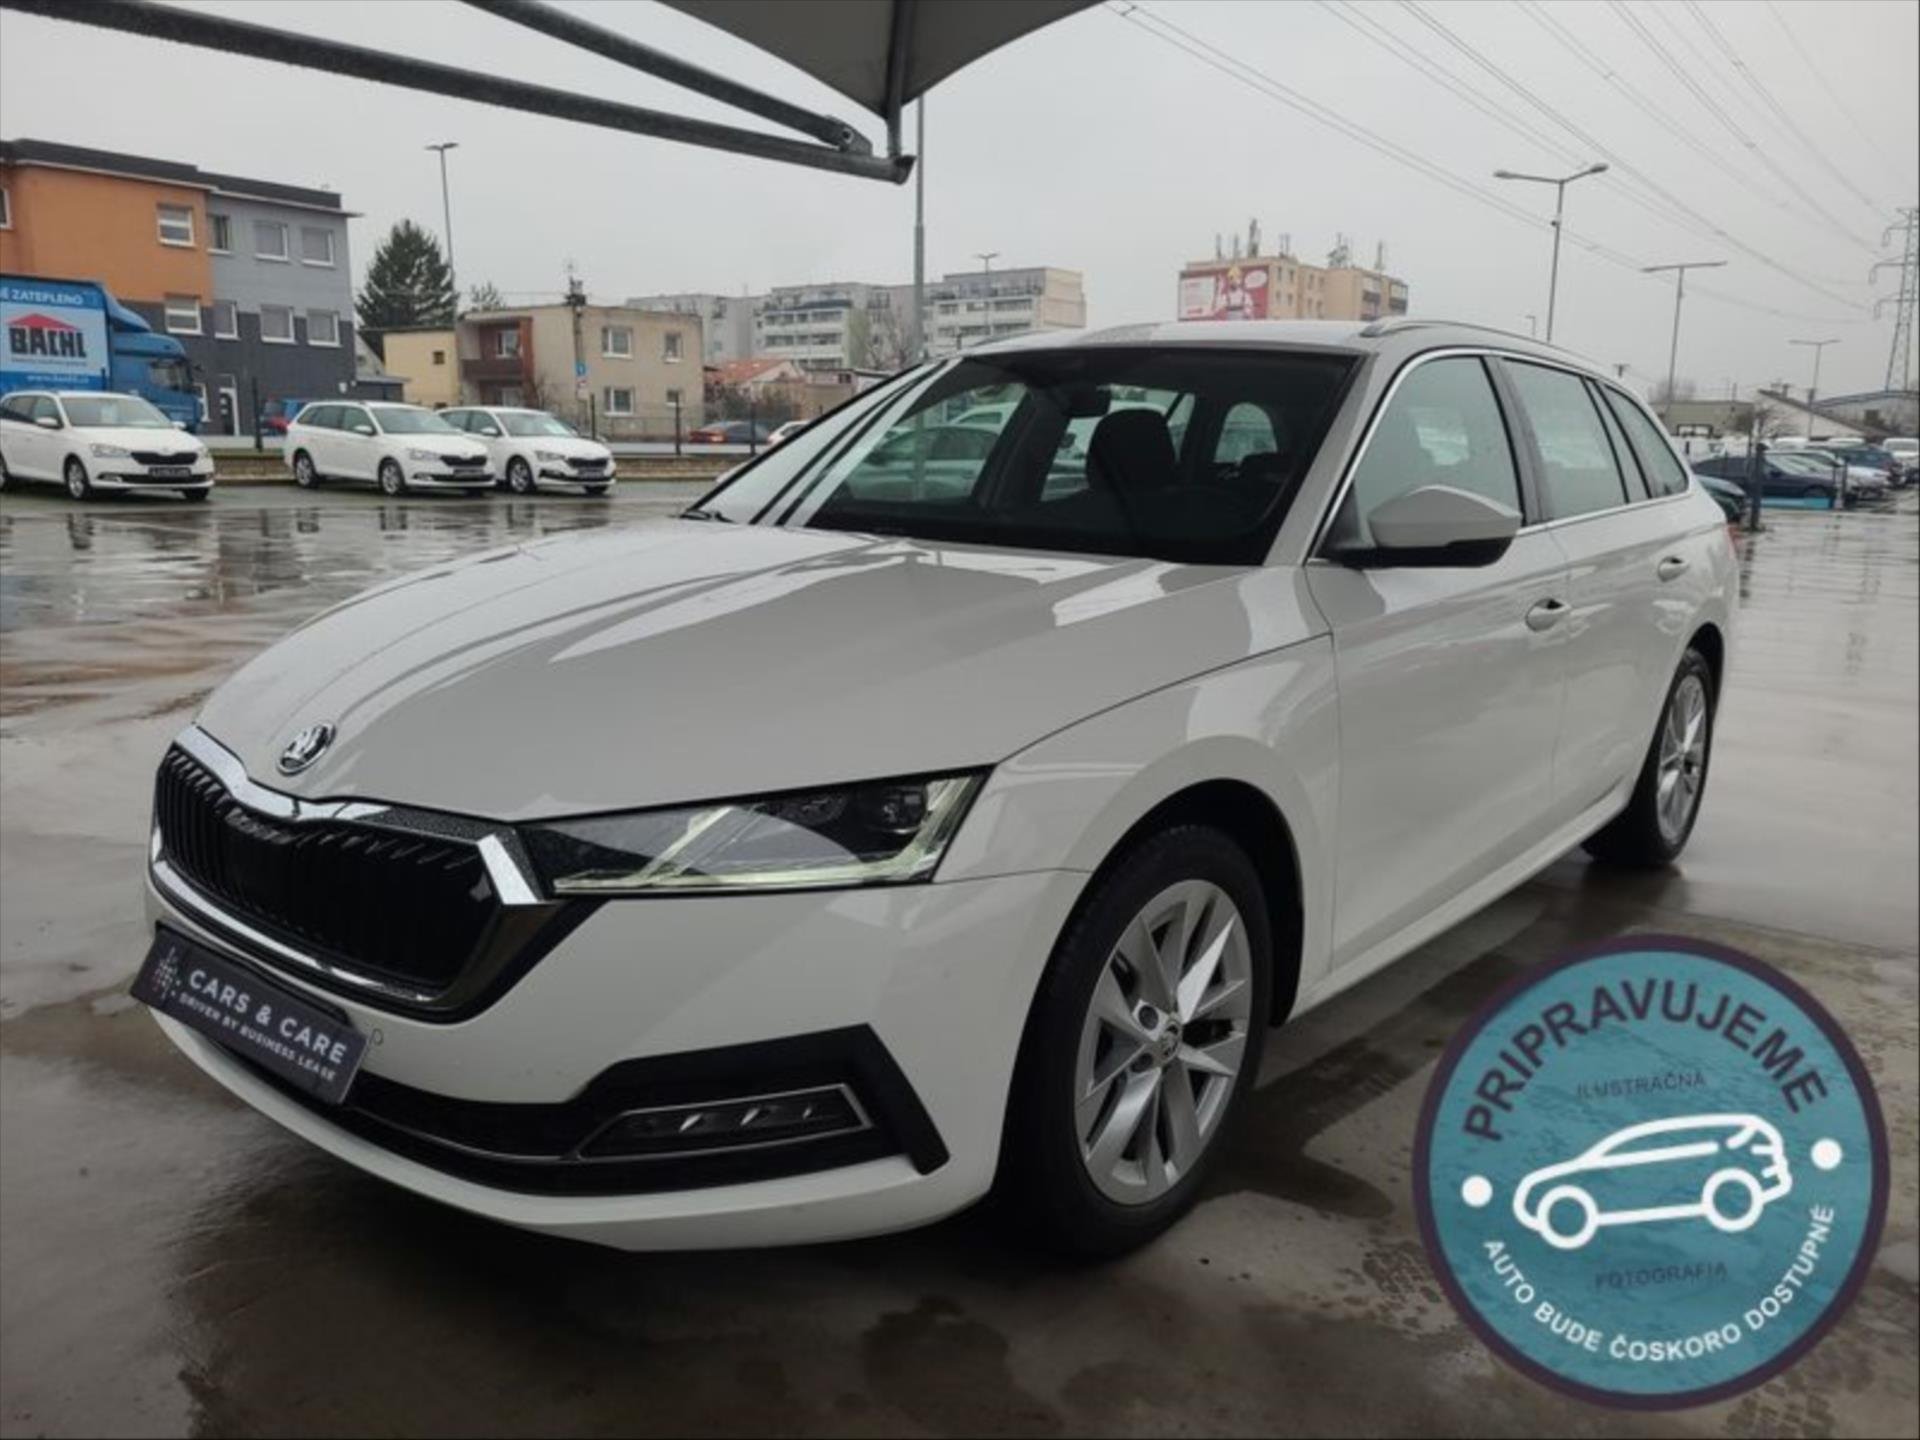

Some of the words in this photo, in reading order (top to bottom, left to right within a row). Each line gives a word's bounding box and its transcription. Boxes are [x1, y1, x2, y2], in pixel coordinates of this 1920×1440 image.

[190, 969, 250, 1013] CARS
[256, 1004, 271, 1026] &
[280, 1017, 347, 1064] CARE
[222, 1015, 240, 1031] BY
[239, 1025, 296, 1060] BUSINESS
[298, 1055, 336, 1081] LEASE
